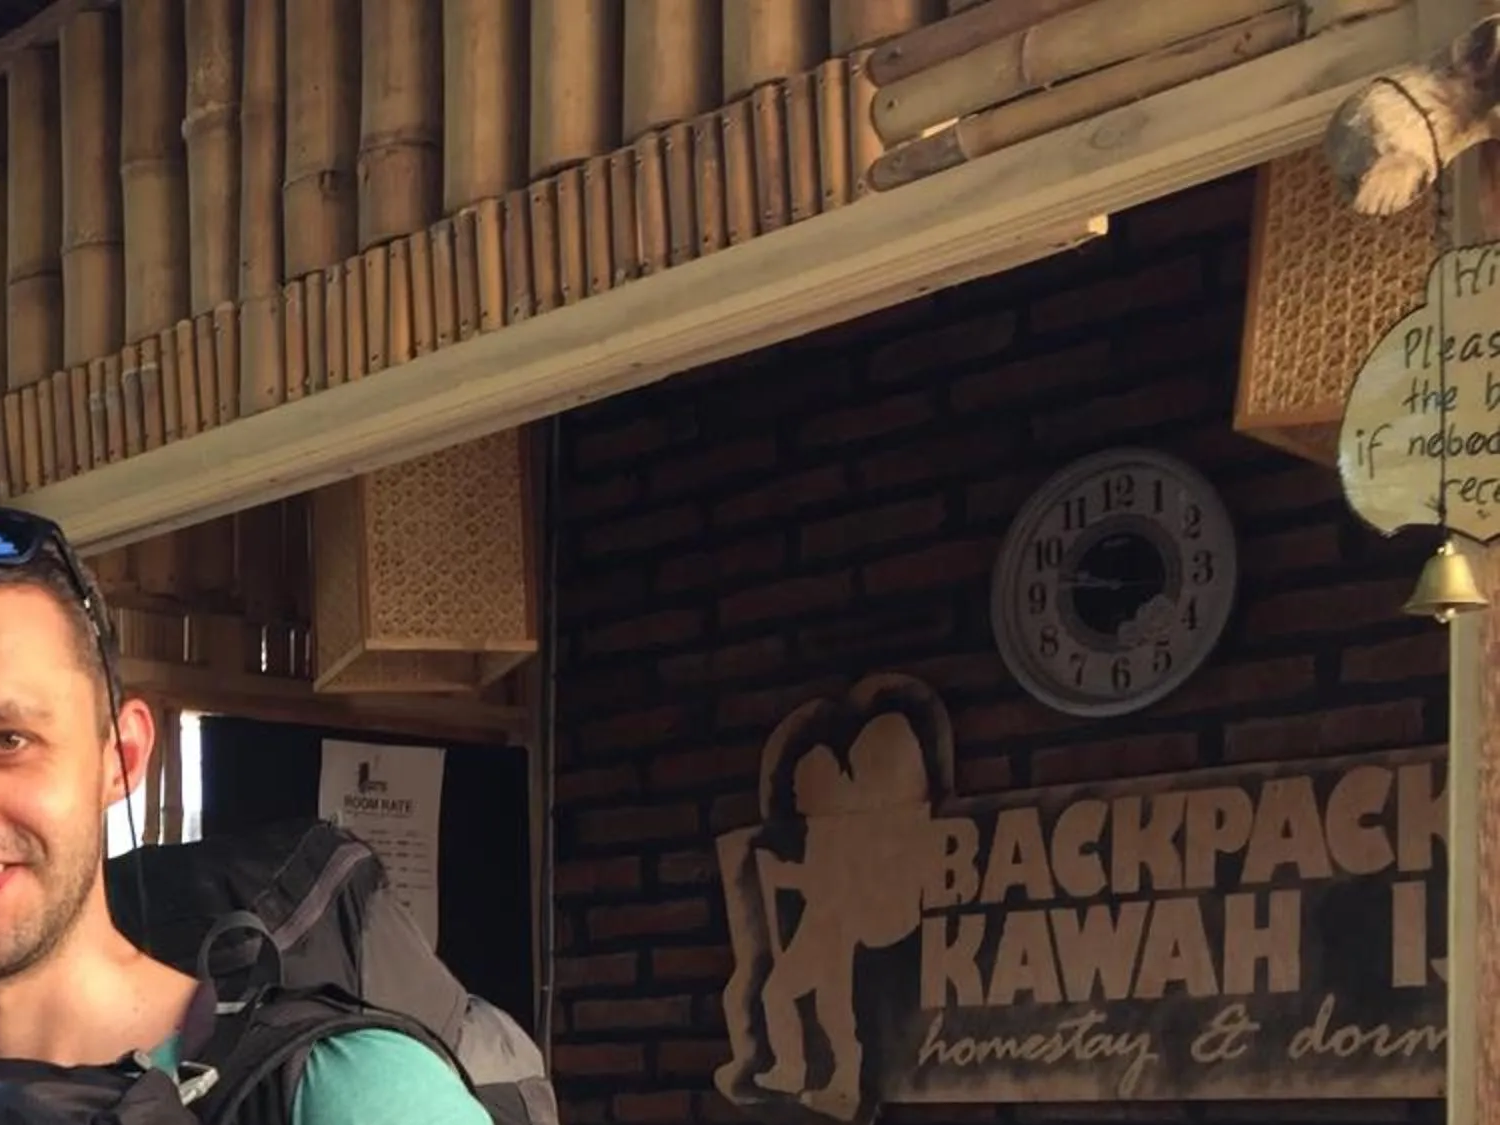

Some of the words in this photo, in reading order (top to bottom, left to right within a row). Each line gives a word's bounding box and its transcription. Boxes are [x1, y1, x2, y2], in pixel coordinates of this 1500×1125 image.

[1401, 376, 1459, 415] the
[1355, 422, 1393, 480] if
[1101, 473, 1135, 513] 12
[1152, 479, 1164, 513] 1
[1062, 496, 1087, 532] 11
[1183, 504, 1201, 540] 2
[1035, 535, 1064, 573] 10
[1192, 551, 1214, 585] 3
[1028, 582, 1047, 616] 9
[1180, 598, 1199, 631] 4
[1039, 624, 1059, 657] 8
[1152, 638, 1173, 673] 5
[1069, 652, 1088, 686] 7
[1111, 655, 1132, 691] 6
[343, 794, 379, 811] ROOM
[381, 798, 414, 814] RATE
[920, 889, 1300, 1009] KAWAH
[1391, 879, 1449, 989] I
[918, 1009, 1159, 1098] homestay
[1190, 1003, 1261, 1063] &
